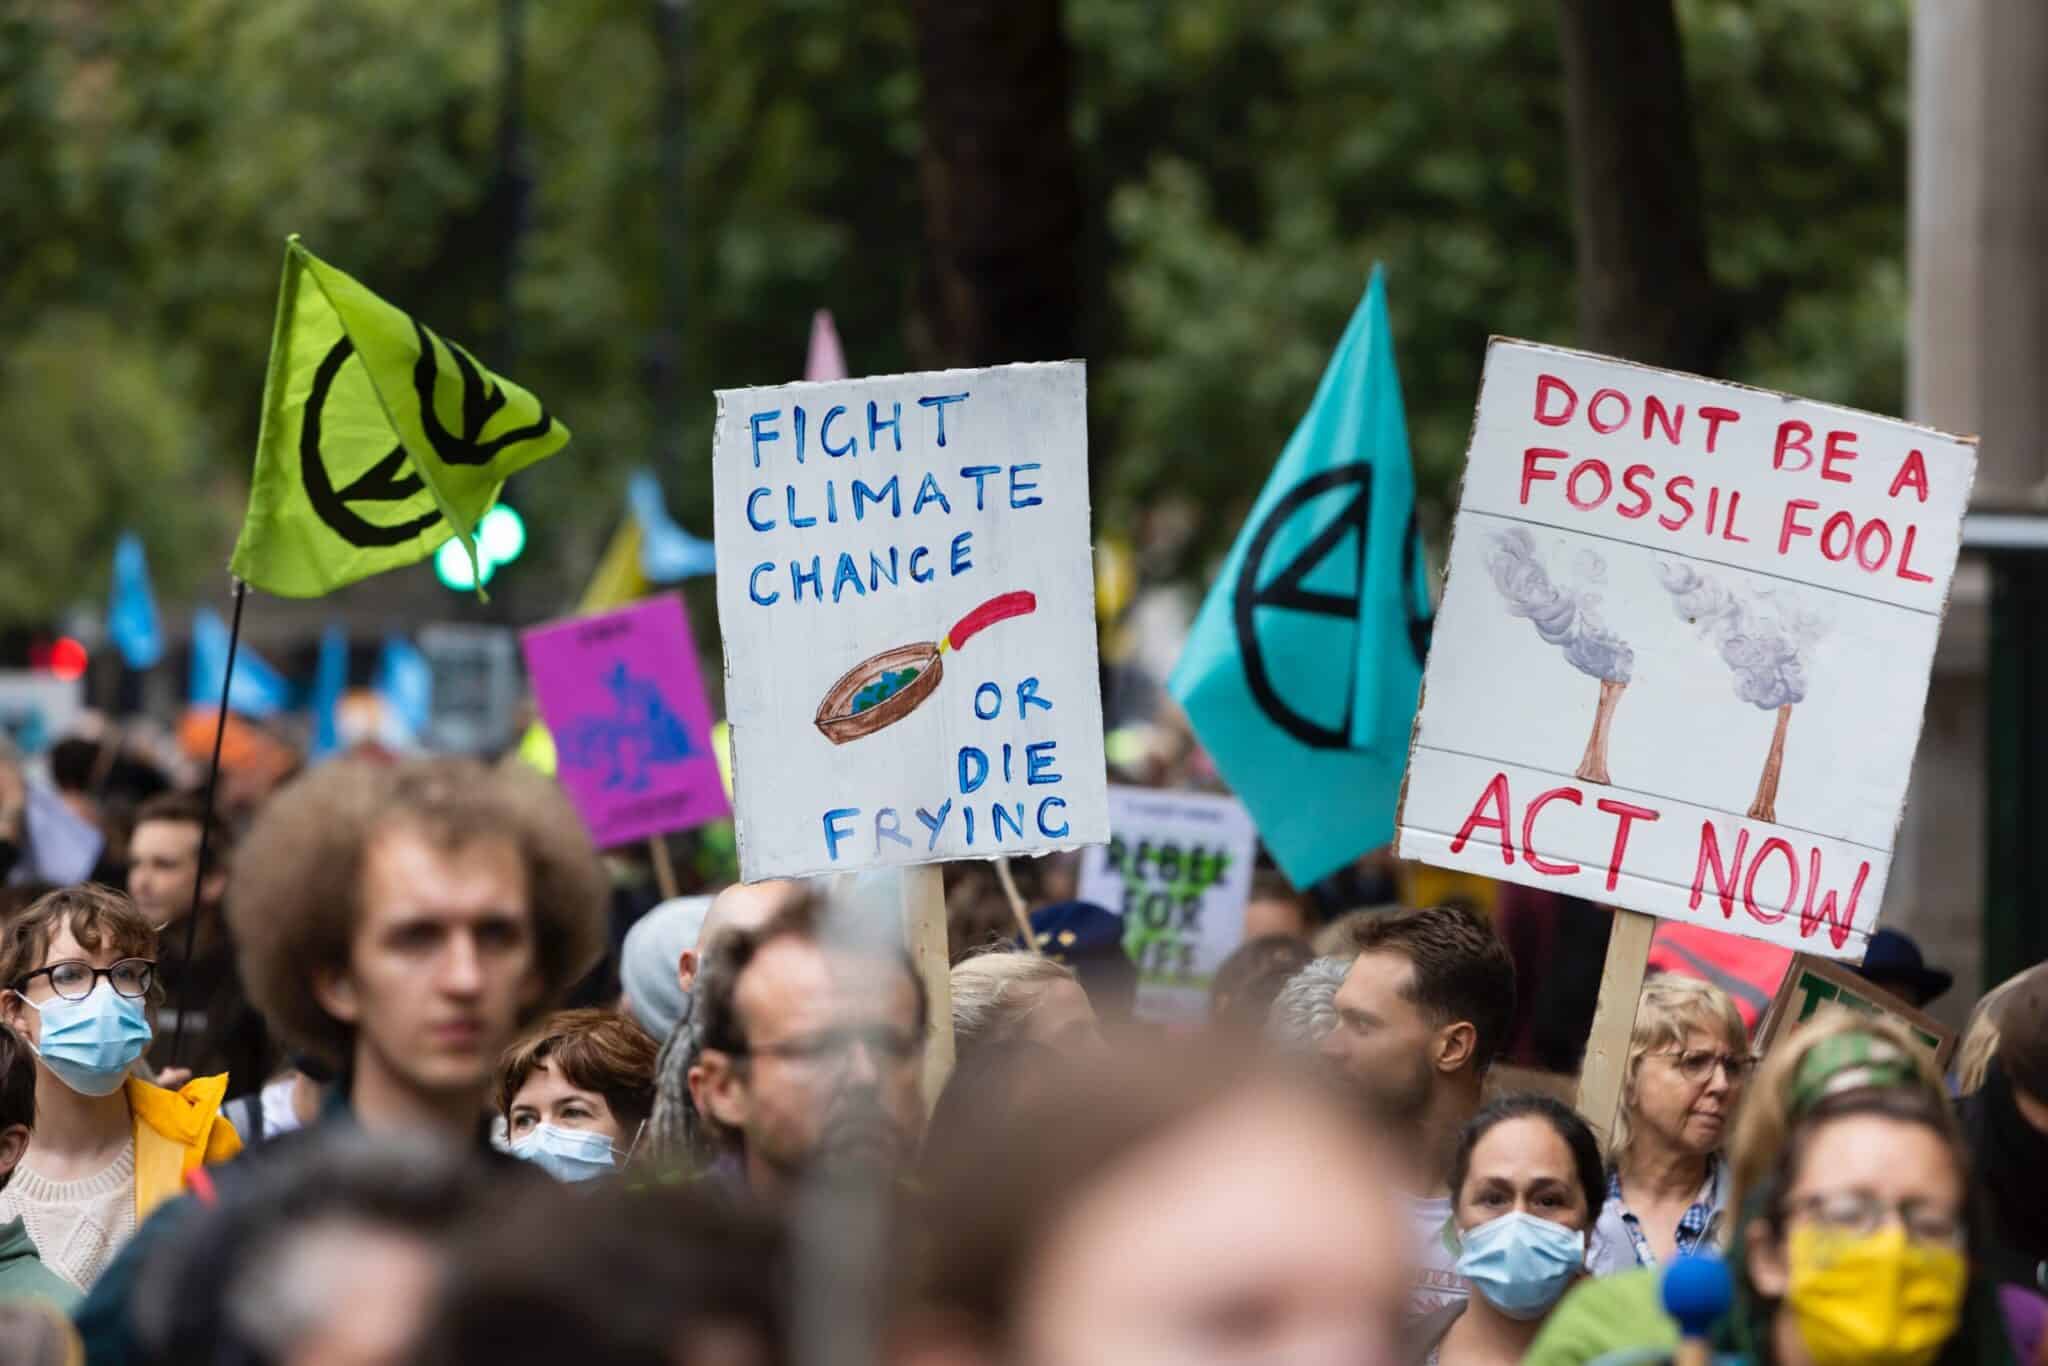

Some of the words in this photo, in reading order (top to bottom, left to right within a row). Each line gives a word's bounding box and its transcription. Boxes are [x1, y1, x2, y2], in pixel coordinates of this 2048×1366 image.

[749, 392, 971, 467] FIGHT
[1534, 374, 1741, 453] DONT
[1772, 419, 1857, 483] BE
[1888, 449, 1929, 503] A
[746, 462, 1043, 532] CLIMATE
[1520, 447, 1749, 543] FOSSIL
[1778, 498, 1934, 583] FOOL
[748, 530, 974, 607] CHANGE
[973, 676, 1053, 720] OR
[957, 740, 1063, 794] DIE
[822, 795, 1071, 861] FRYING
[1450, 772, 1659, 892] ACT
[1689, 820, 1870, 950] NOW
